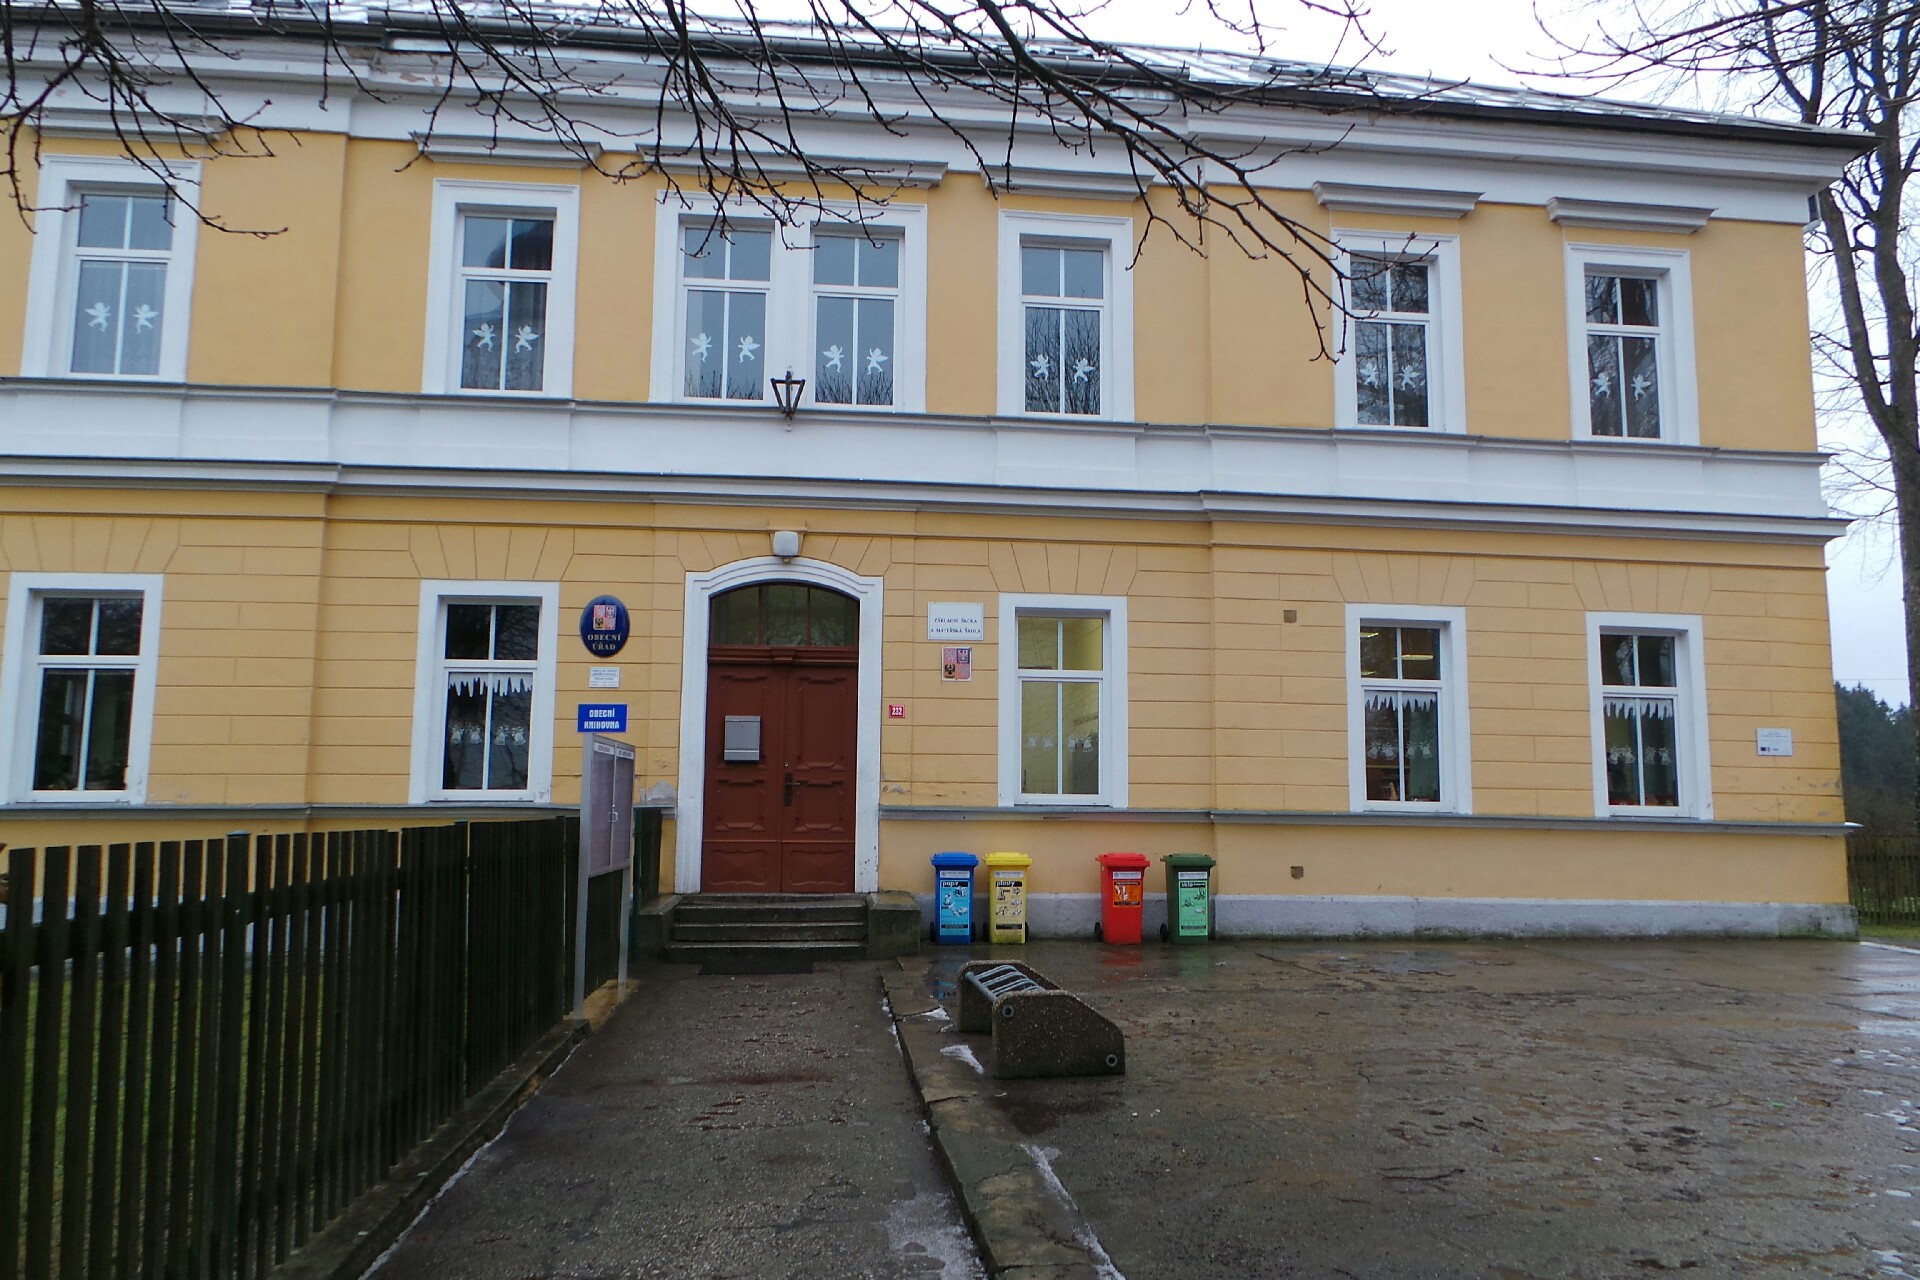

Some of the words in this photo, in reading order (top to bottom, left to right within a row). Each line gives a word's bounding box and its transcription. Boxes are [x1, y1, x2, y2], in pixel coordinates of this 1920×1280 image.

[587, 632, 622, 641] OBECNÍ
[592, 641, 616, 650] ÚŘAD
[589, 707, 615, 718] OBECNÍ
[583, 720, 620, 730] KNIHOVNA
